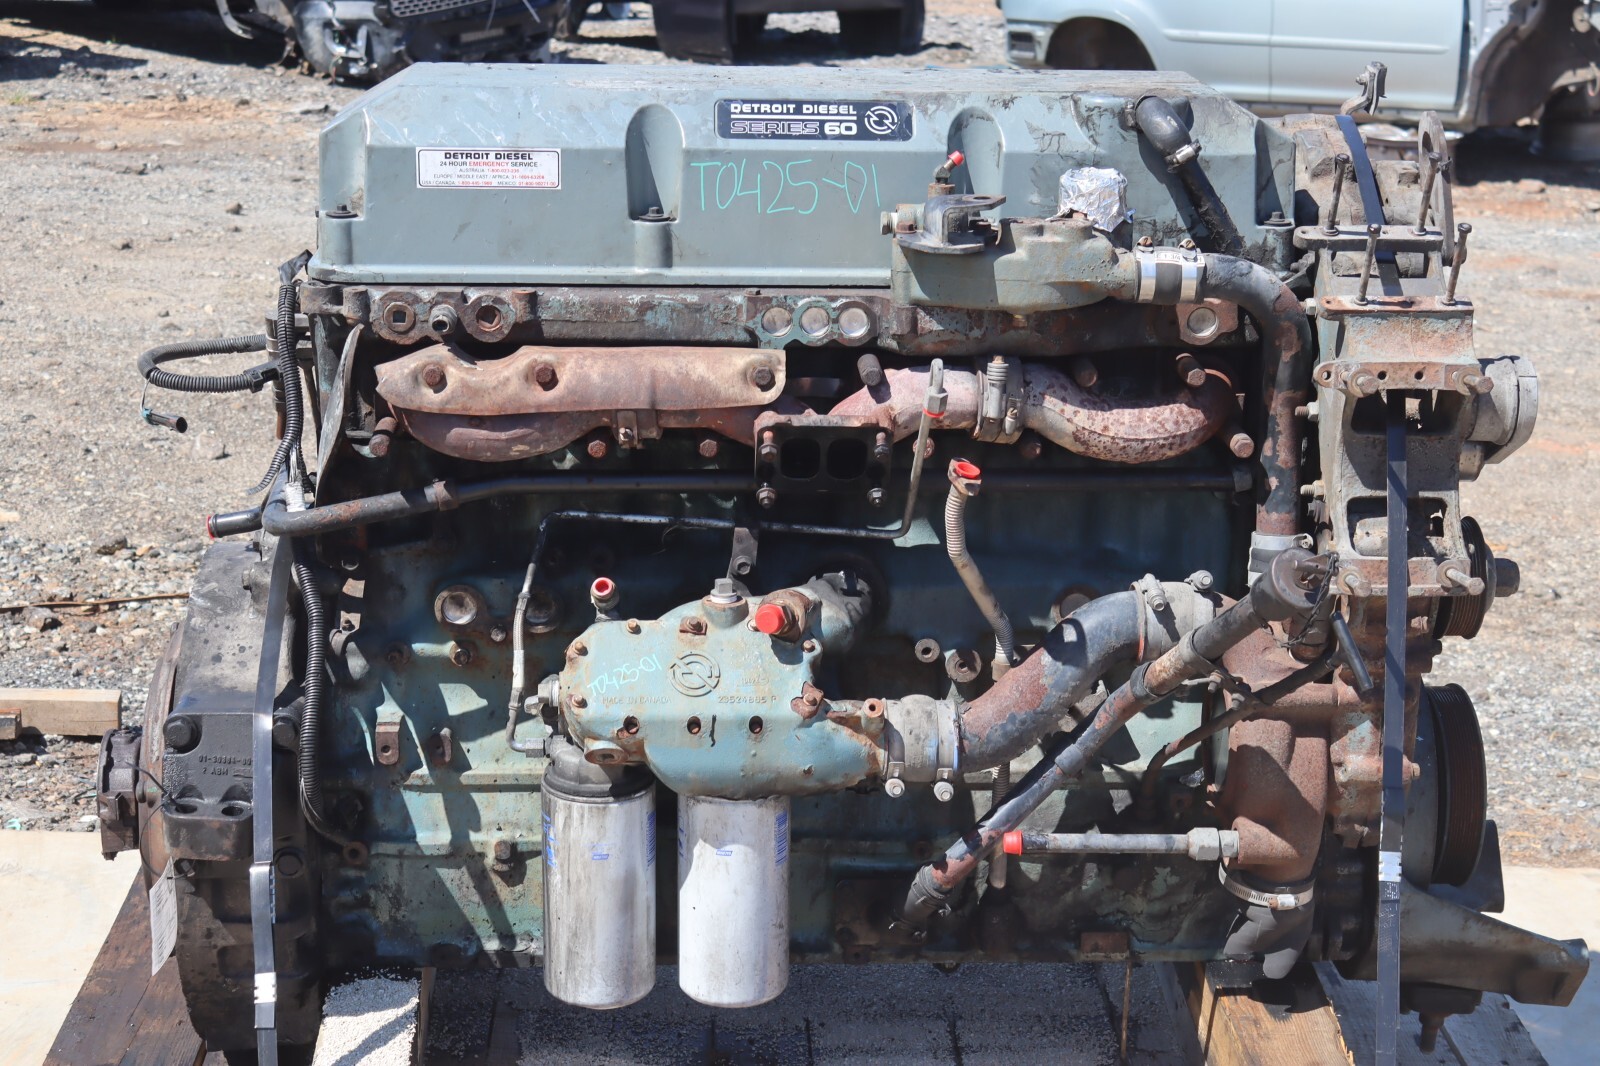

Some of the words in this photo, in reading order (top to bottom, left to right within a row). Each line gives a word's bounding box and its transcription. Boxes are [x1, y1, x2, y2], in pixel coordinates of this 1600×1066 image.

[730, 103, 796, 114] DETROIT
[802, 104, 858, 115] DIESEL
[730, 120, 820, 135] SERIES
[824, 122, 858, 136] 60
[444, 152, 491, 160] DETROIT
[494, 152, 534, 161] DIESEL
[602, 696, 624, 705] MADE
[626, 696, 638, 705] IN
[640, 696, 672, 705] CANADA
